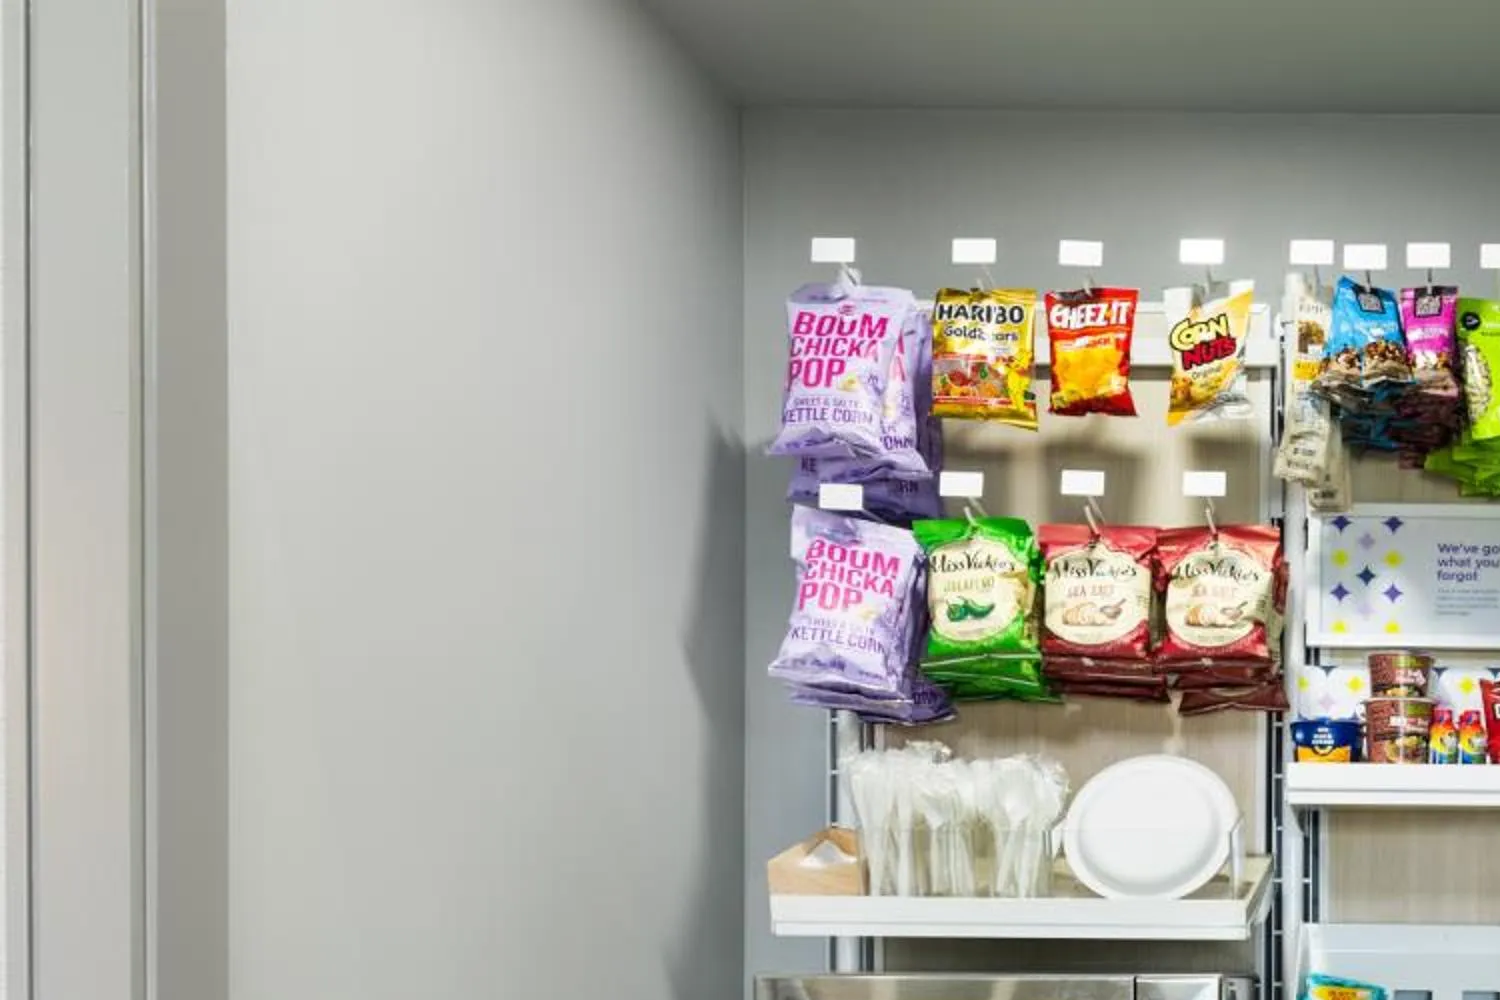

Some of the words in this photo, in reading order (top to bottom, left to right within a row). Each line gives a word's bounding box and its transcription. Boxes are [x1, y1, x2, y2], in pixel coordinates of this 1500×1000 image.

[790, 336, 879, 363] CHICKA
[1181, 335, 1237, 371] NUTS
[788, 357, 846, 392] POP
[1437, 543, 1478, 554] We've
[1437, 556, 1471, 568] what
[1475, 558, 1500, 570] you
[802, 560, 895, 598] CHICKA
[1437, 569, 1478, 583] forgot
[797, 581, 863, 612] POP
